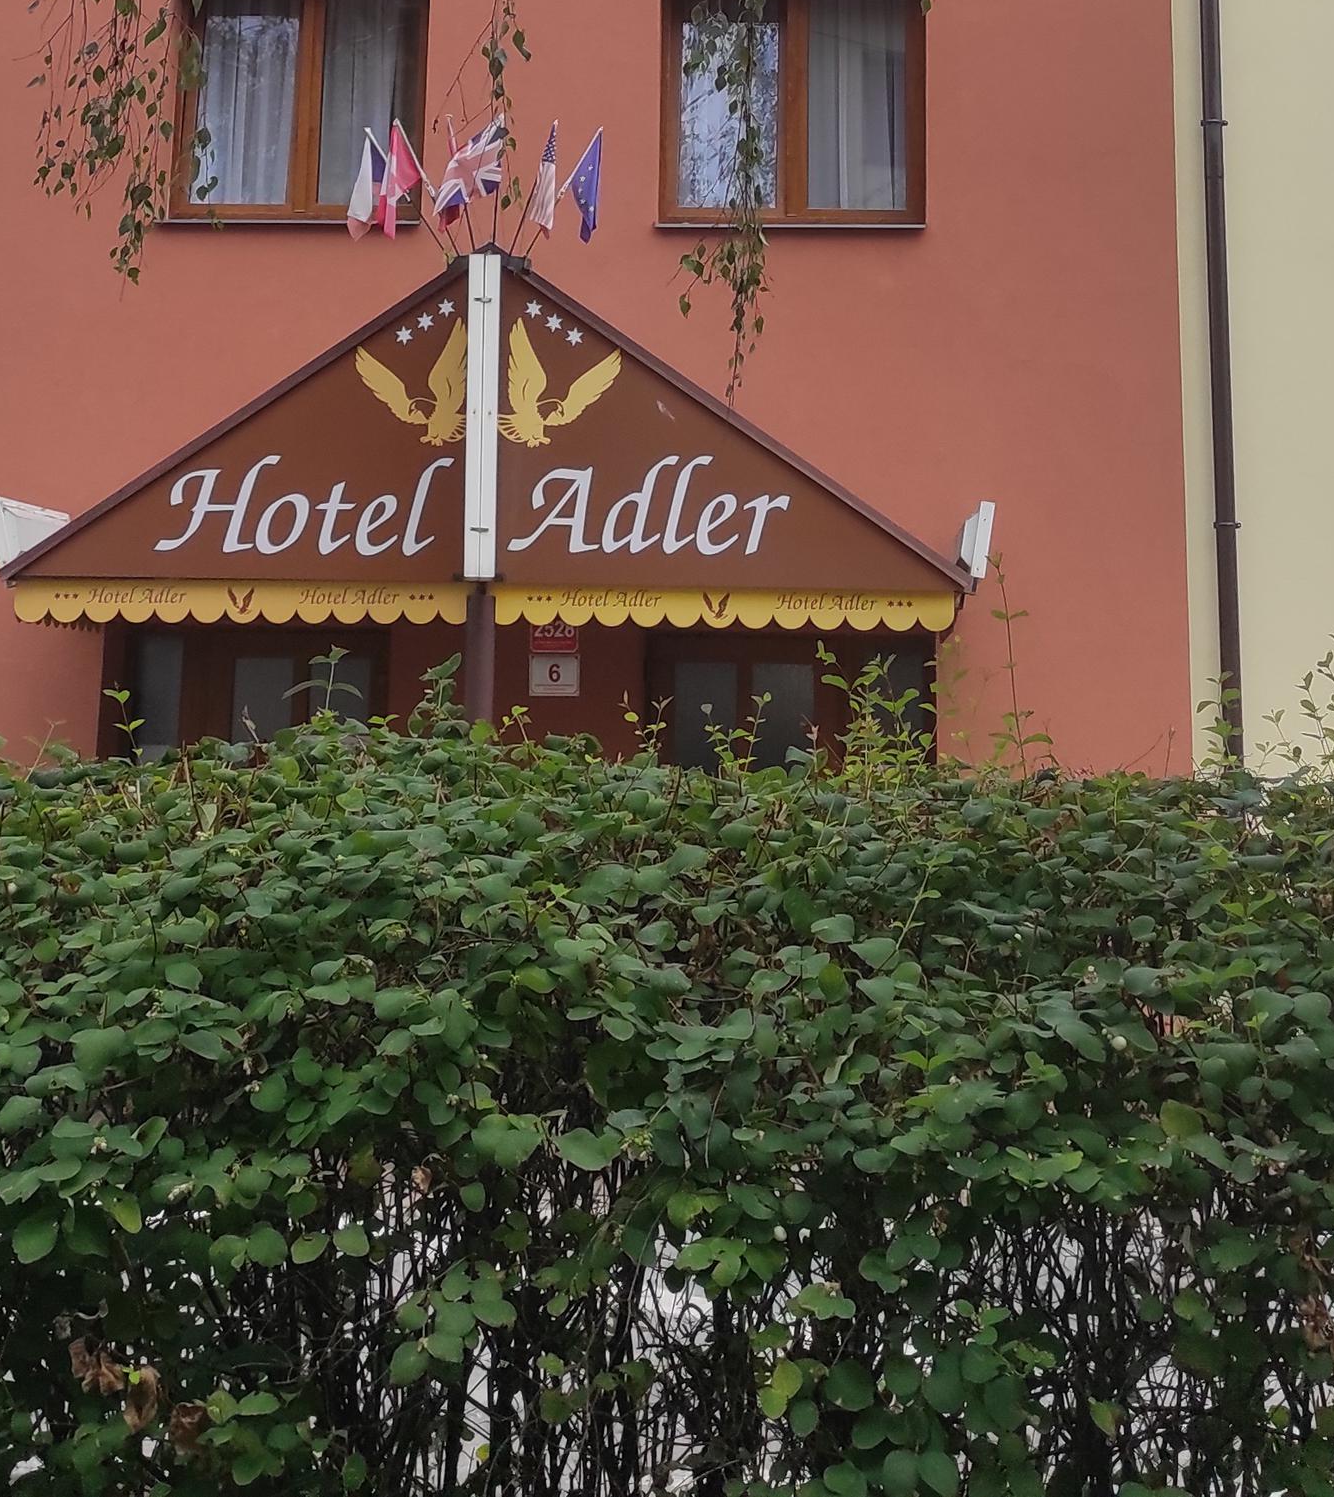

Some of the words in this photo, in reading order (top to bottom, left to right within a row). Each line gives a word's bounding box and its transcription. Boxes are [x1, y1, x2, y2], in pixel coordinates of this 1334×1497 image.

[153, 454, 455, 557] Hotel
[507, 455, 790, 556] Adler
[86, 586, 136, 604] Hotel
[138, 587, 187, 604] Adler
[299, 586, 348, 605] Hotel
[351, 586, 400, 605] Adler
[560, 589, 610, 608] Hotel
[613, 589, 662, 608] Adler
[775, 593, 826, 611] Hotel
[828, 593, 877, 611] Adler
[548, 663, 562, 682] 6
